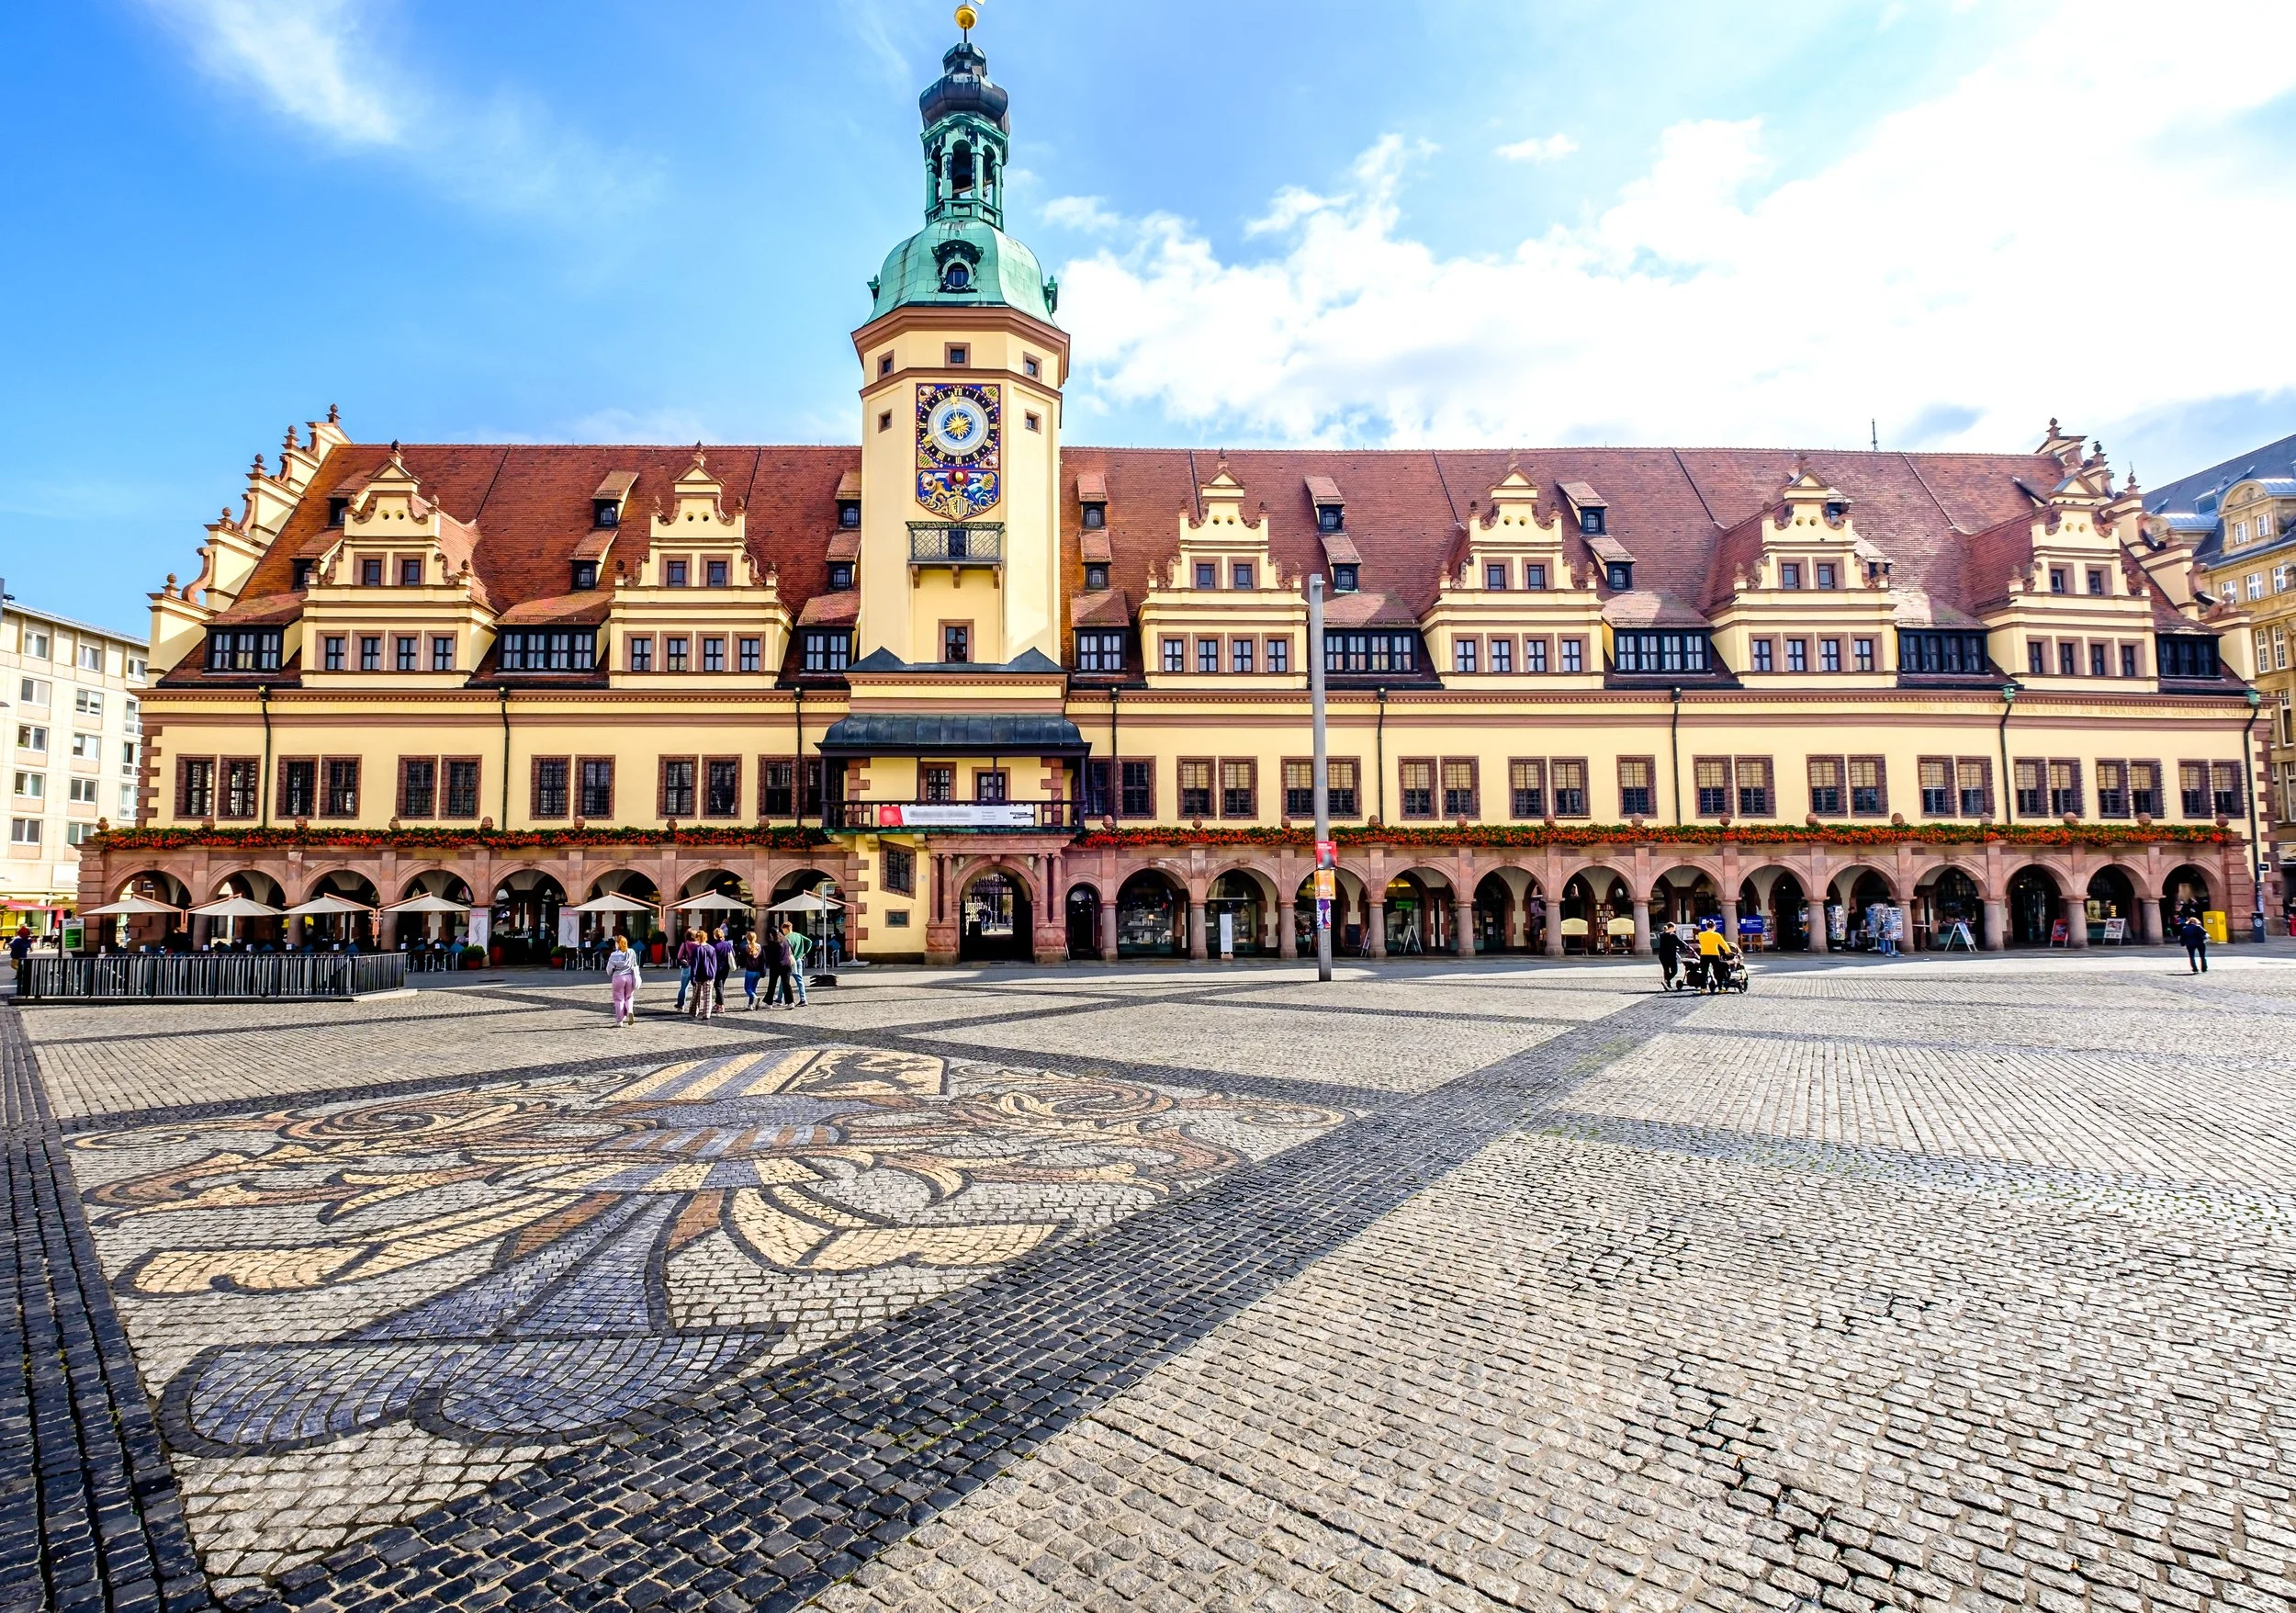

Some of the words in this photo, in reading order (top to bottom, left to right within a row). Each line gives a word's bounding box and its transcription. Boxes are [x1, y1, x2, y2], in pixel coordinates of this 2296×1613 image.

[2043, 705, 2072, 714] STADT
[2080, 706, 2093, 715] ZU
[2171, 708, 2217, 716] GEMEINES
